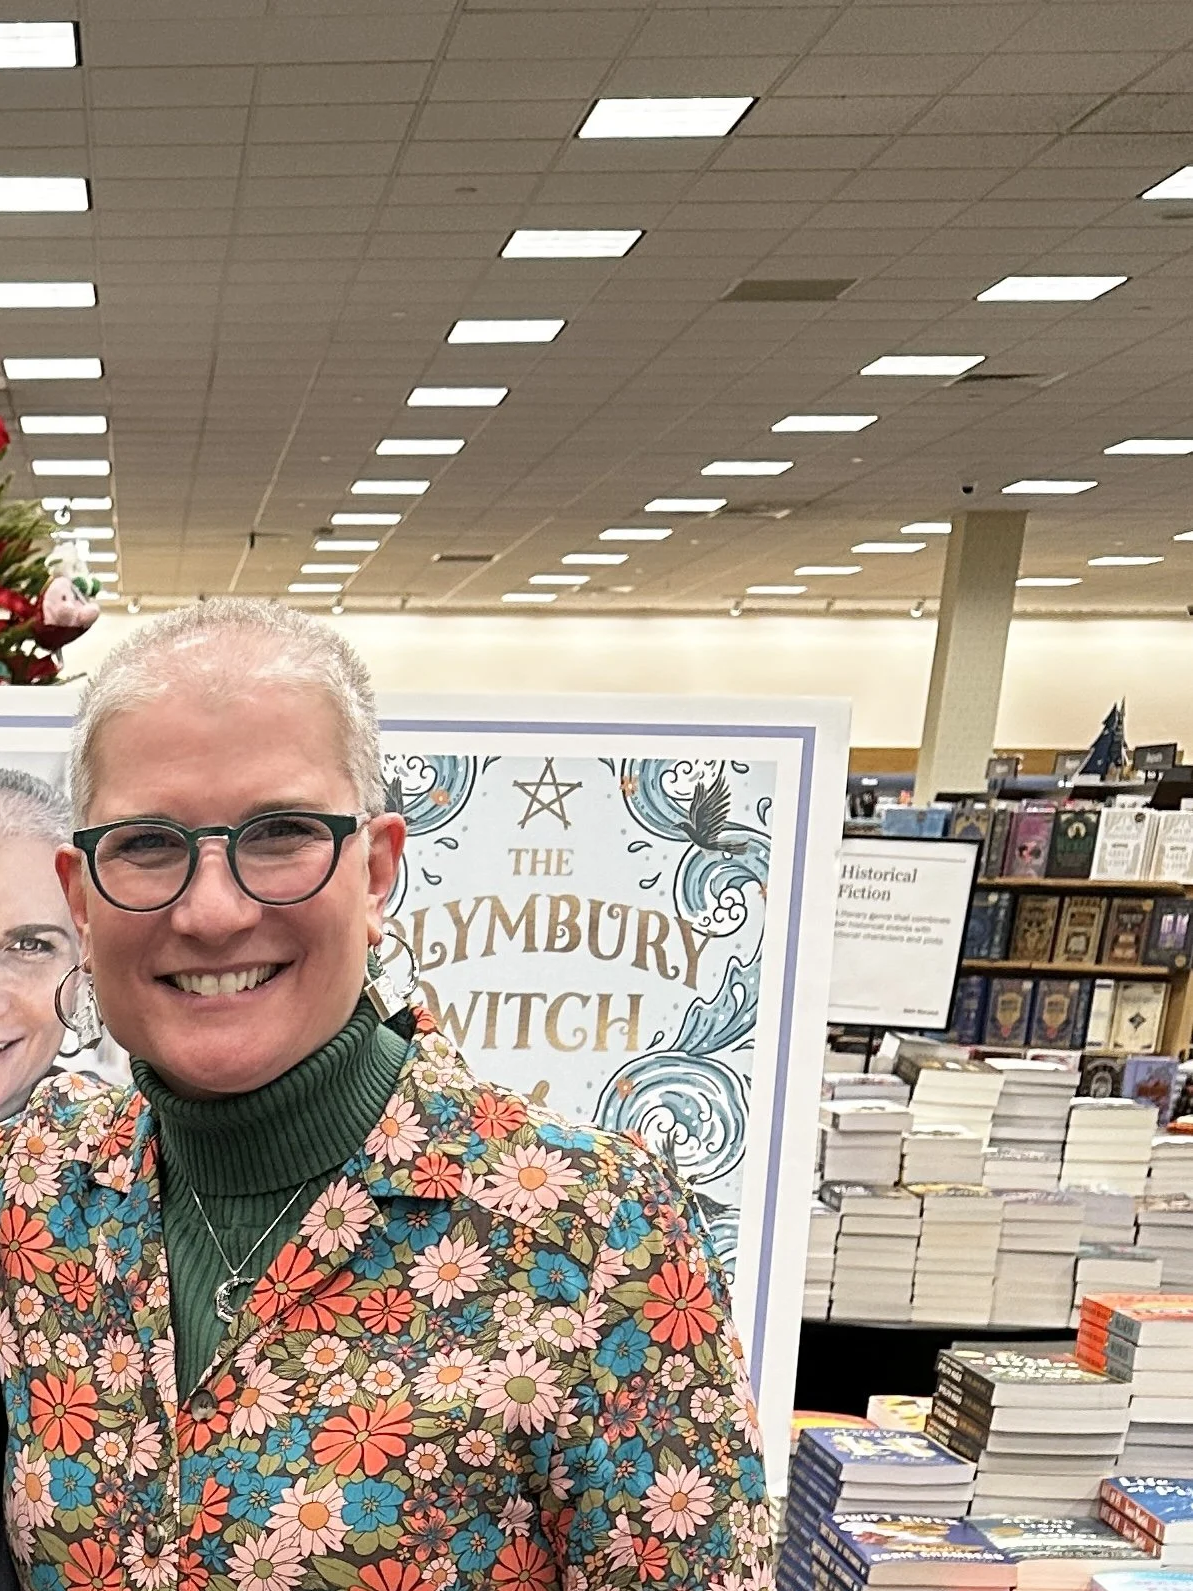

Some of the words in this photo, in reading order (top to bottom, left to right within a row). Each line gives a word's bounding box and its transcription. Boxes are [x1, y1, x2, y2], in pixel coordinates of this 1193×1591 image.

[508, 847, 575, 876] THE
[841, 864, 919, 884] Historical
[838, 884, 892, 902] Fiction
[415, 980, 644, 1053] WITCH
[832, 1513, 892, 1524] SWIFT
